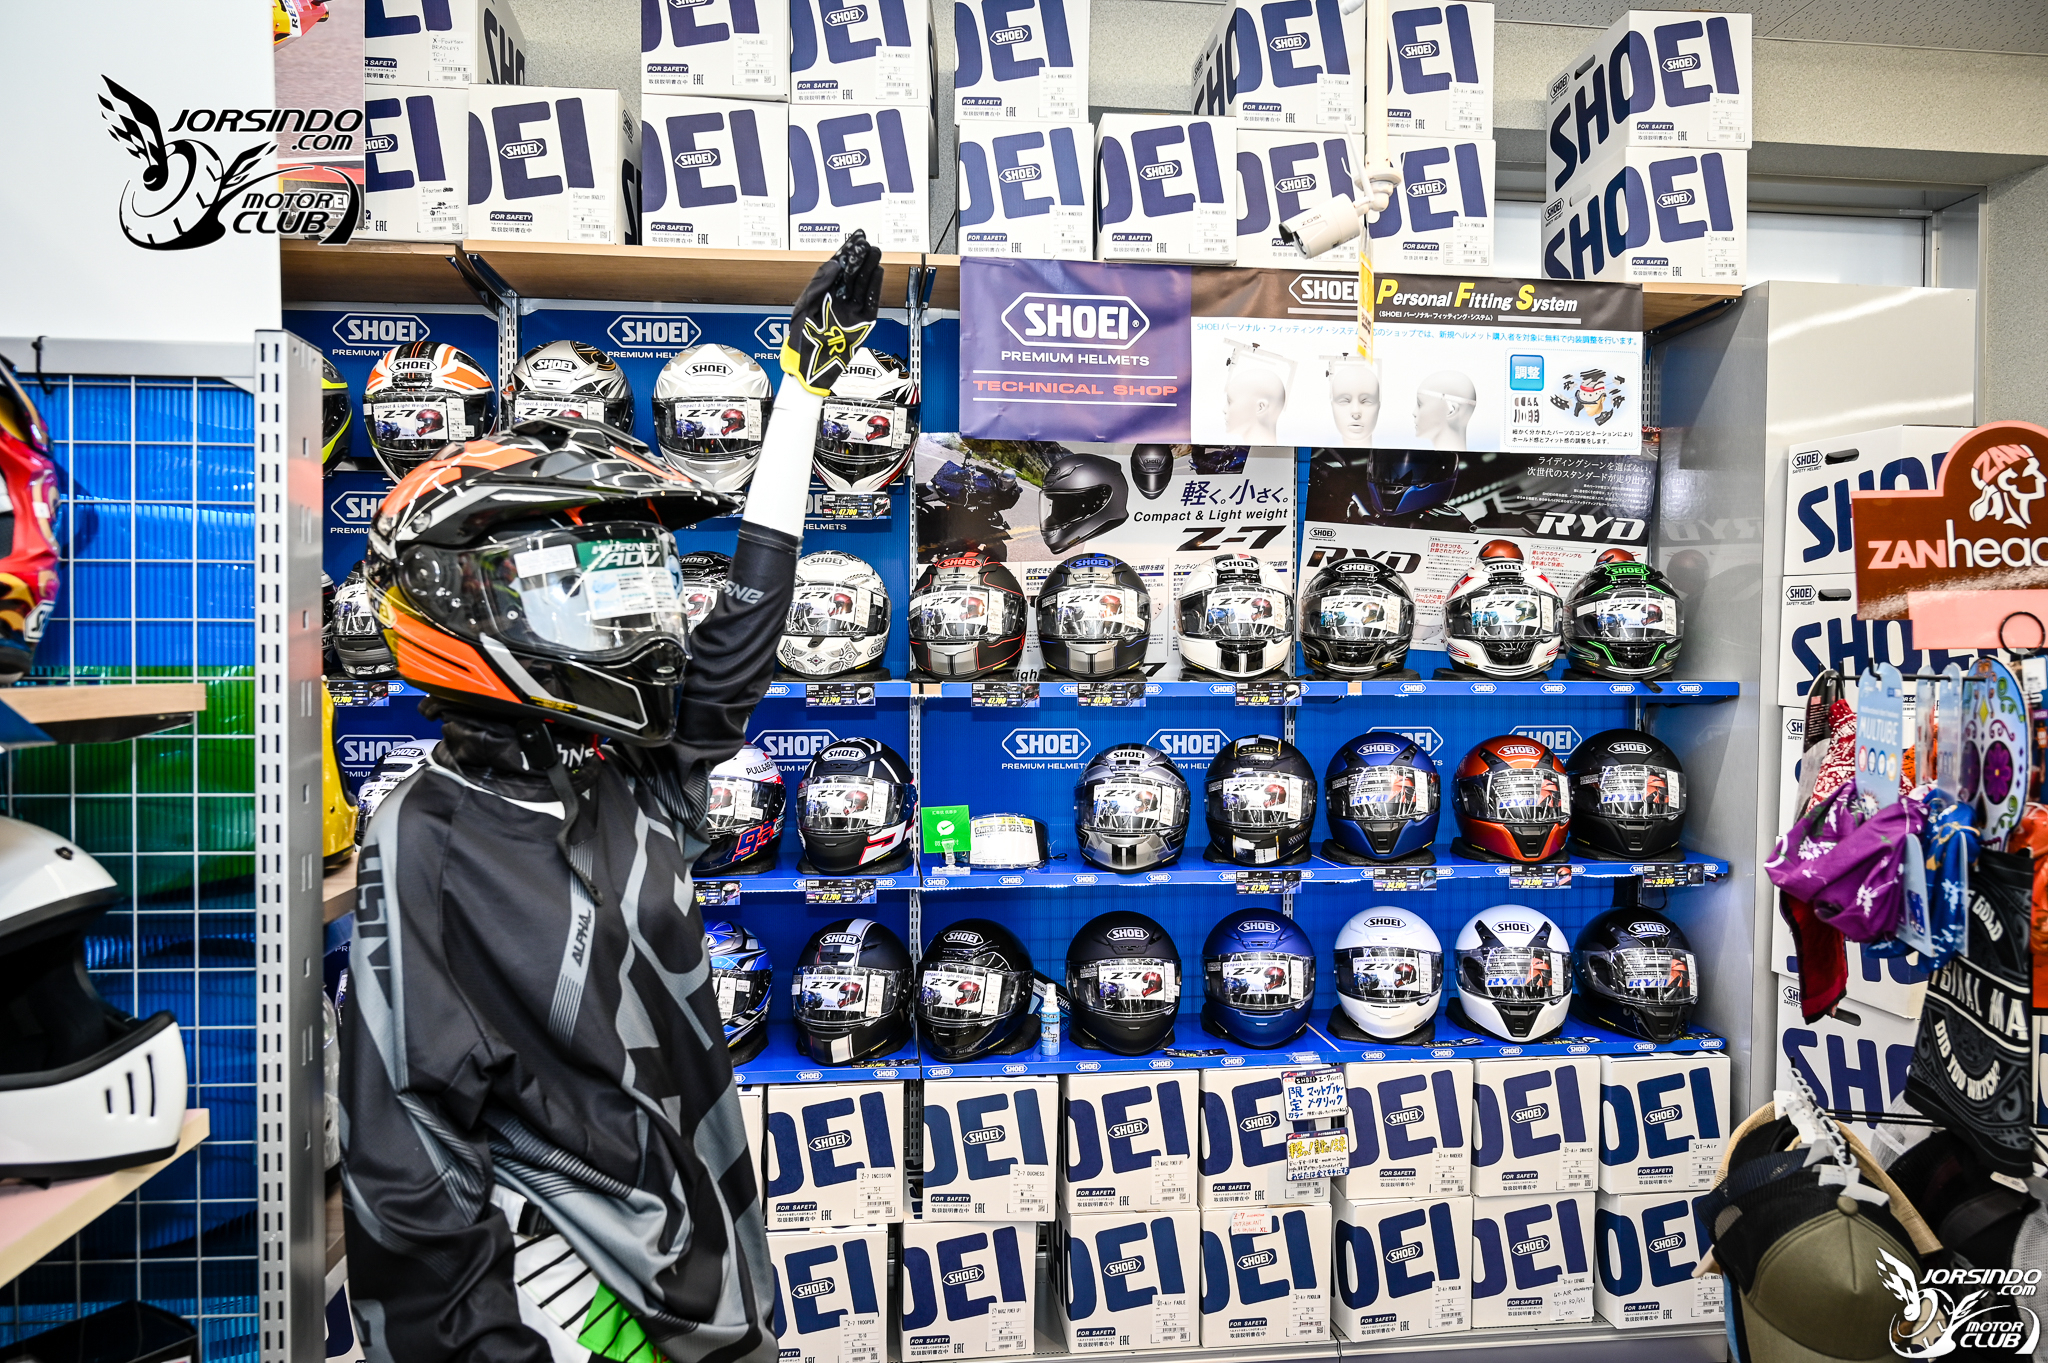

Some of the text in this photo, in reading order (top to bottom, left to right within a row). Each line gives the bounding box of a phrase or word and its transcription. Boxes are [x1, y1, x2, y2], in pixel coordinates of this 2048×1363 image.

[831, 10, 859, 23] SHOEI
[995, 27, 1023, 43] SHOEI
[1275, 36, 1302, 49] SHOEI
[1404, 44, 1431, 56] SHOEI
[1667, 57, 1693, 70] SHOEI
[366, 138, 388, 151] HOEI
[505, 143, 538, 156] SHOEI
[681, 153, 712, 165] SHOEI
[834, 153, 861, 167] SHOEI
[1005, 167, 1034, 181] SHOEI
[1146, 165, 1173, 178] SHOEI
[1280, 177, 1310, 191] SHOEI
[1412, 182, 1441, 195] SHOEI
[1662, 193, 1687, 205] SHOEI
[506, 213, 533, 221] SAFETY
[1376, 279, 1578, 312] Personal Fitting System
[1024, 302, 1129, 340] SHOEI
[348, 320, 416, 341] SHOEI
[622, 322, 690, 343] SHOEI
[332, 348, 374, 356] PREMIUM
[1001, 351, 1150, 366] PREMIUM HELMETS
[1514, 366, 1540, 380] 調整
[972, 380, 1177, 396] TECHNICAL SHOP
[383, 410, 416, 419] Z-7
[687, 409, 721, 418] Z-7
[834, 411, 868, 422] Z-7
[1796, 452, 1819, 466] SHOEI
[1973, 444, 2033, 483] ZAN
[1133, 507, 1288, 523] Compact & Light weight
[1536, 511, 1645, 541] RYD
[1176, 525, 1287, 551] Z-7
[1790, 587, 1812, 598] SHOEI
[1015, 734, 1079, 754] SHOEI
[1243, 922, 1275, 931] SHOEI
[1370, 918, 1401, 926] SHOEI
[1497, 923, 1530, 932] SHOEI
[1112, 929, 1144, 938] SHOEI
[1390, 1110, 1419, 1123] SHOEI
[1516, 1107, 1542, 1120] SHOEI
[1649, 1108, 1676, 1122] SHOEI
[1113, 1121, 1144, 1135] SHOEI
[1246, 1116, 1273, 1130] SHOEI
[814, 1134, 846, 1149] SHOEI
[968, 1129, 1000, 1143] SHOEI
[1517, 1238, 1546, 1253] SHOEI
[1653, 1236, 1679, 1250] SHOEI
[1241, 1252, 1270, 1267] SHOEI
[1390, 1247, 1416, 1261] SHOEI
[1109, 1260, 1137, 1274] SHOEI
[949, 1269, 980, 1283] SHOEI
[798, 1282, 829, 1296] SHOEI
